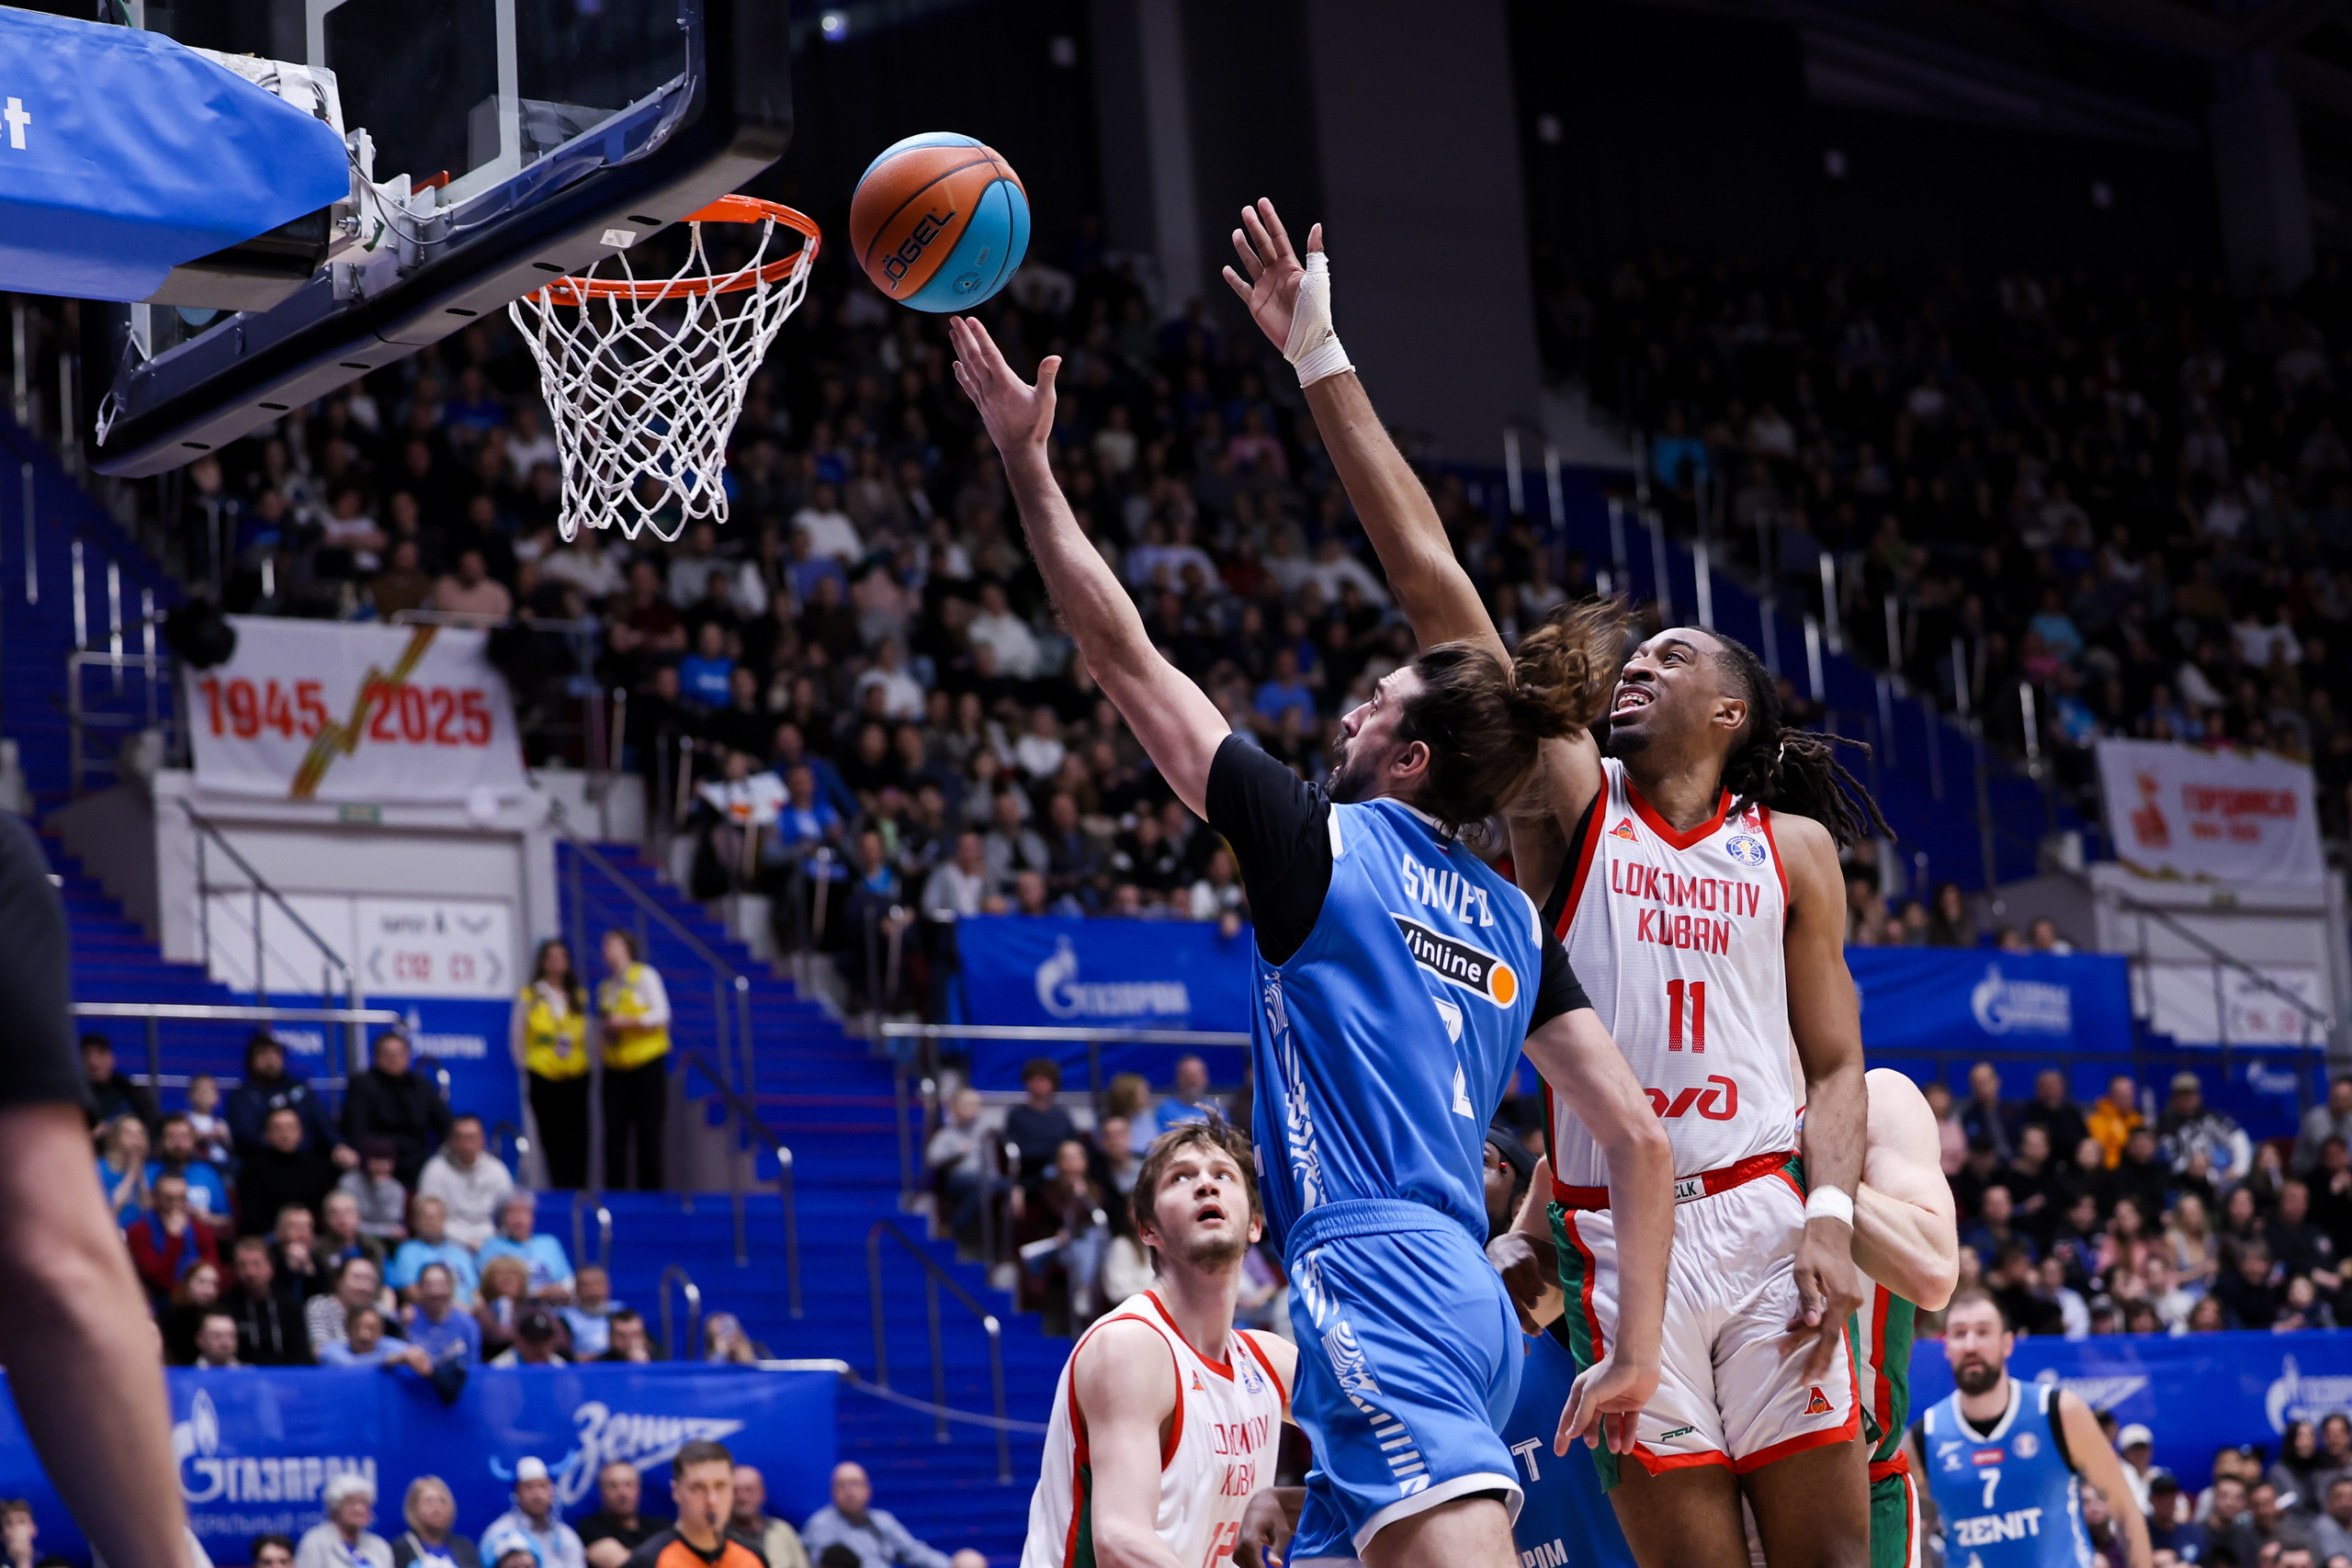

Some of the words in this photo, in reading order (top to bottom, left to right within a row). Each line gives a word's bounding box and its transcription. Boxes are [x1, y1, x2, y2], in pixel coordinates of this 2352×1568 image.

[0, 96, 31, 150] t
[882, 210, 956, 291] JÖGEL
[200, 677, 326, 740] 1945
[365, 679, 493, 748] 2025
[1611, 859, 1760, 919] LOKOMOTIV
[1405, 929, 1482, 983] inline
[1637, 908, 1730, 956] KUBAN
[1667, 978, 1705, 1054] 11
[1979, 1467, 2001, 1508] 7
[1953, 1507, 2043, 1547] ZENIT
